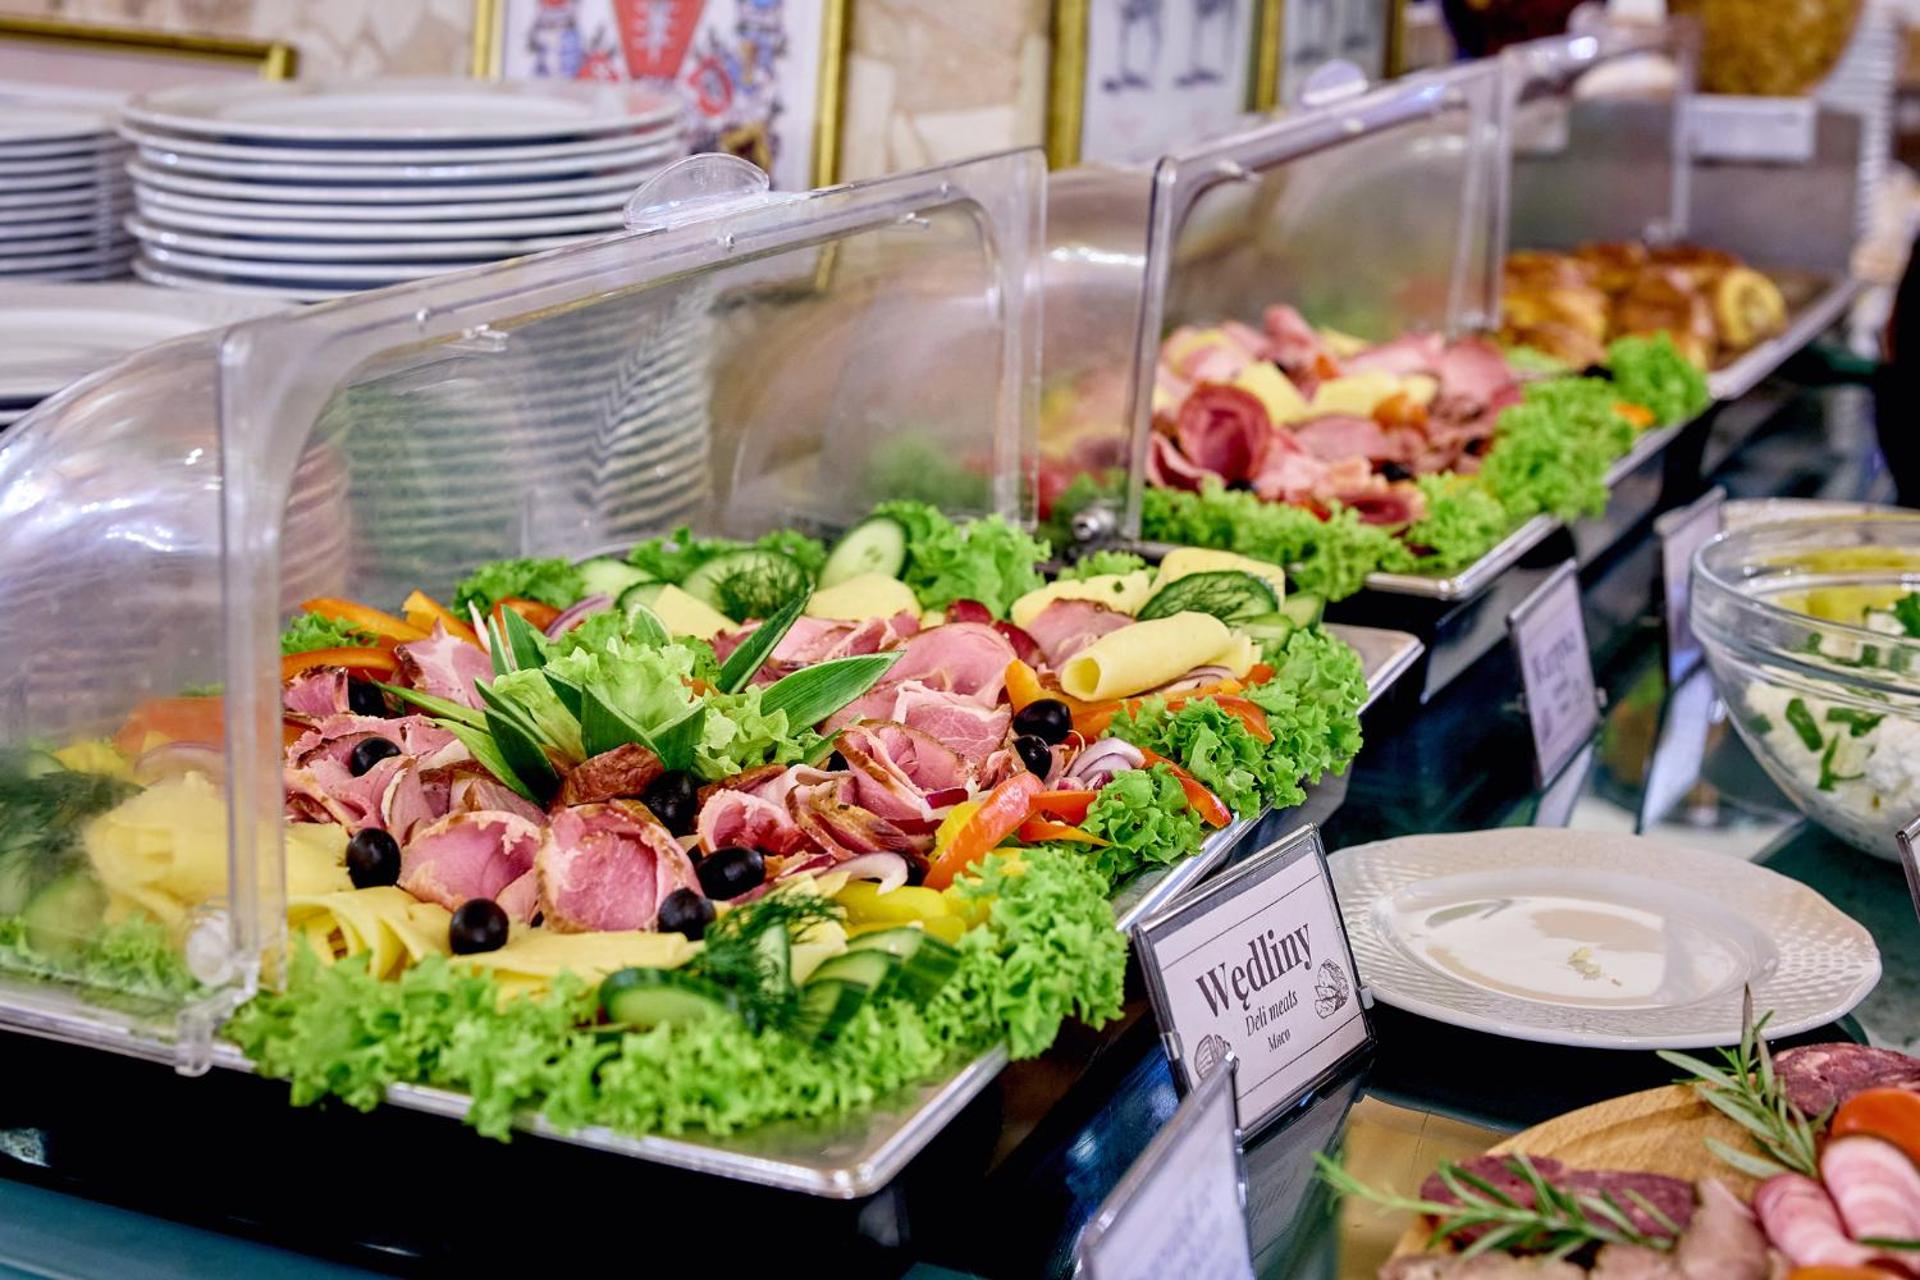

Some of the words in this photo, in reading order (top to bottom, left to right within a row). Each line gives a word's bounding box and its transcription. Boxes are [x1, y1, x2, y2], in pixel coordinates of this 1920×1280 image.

[1195, 923, 1313, 1018] Wędliny
[1244, 1005, 1268, 1037] Deli
[1268, 990, 1299, 1022] meats
